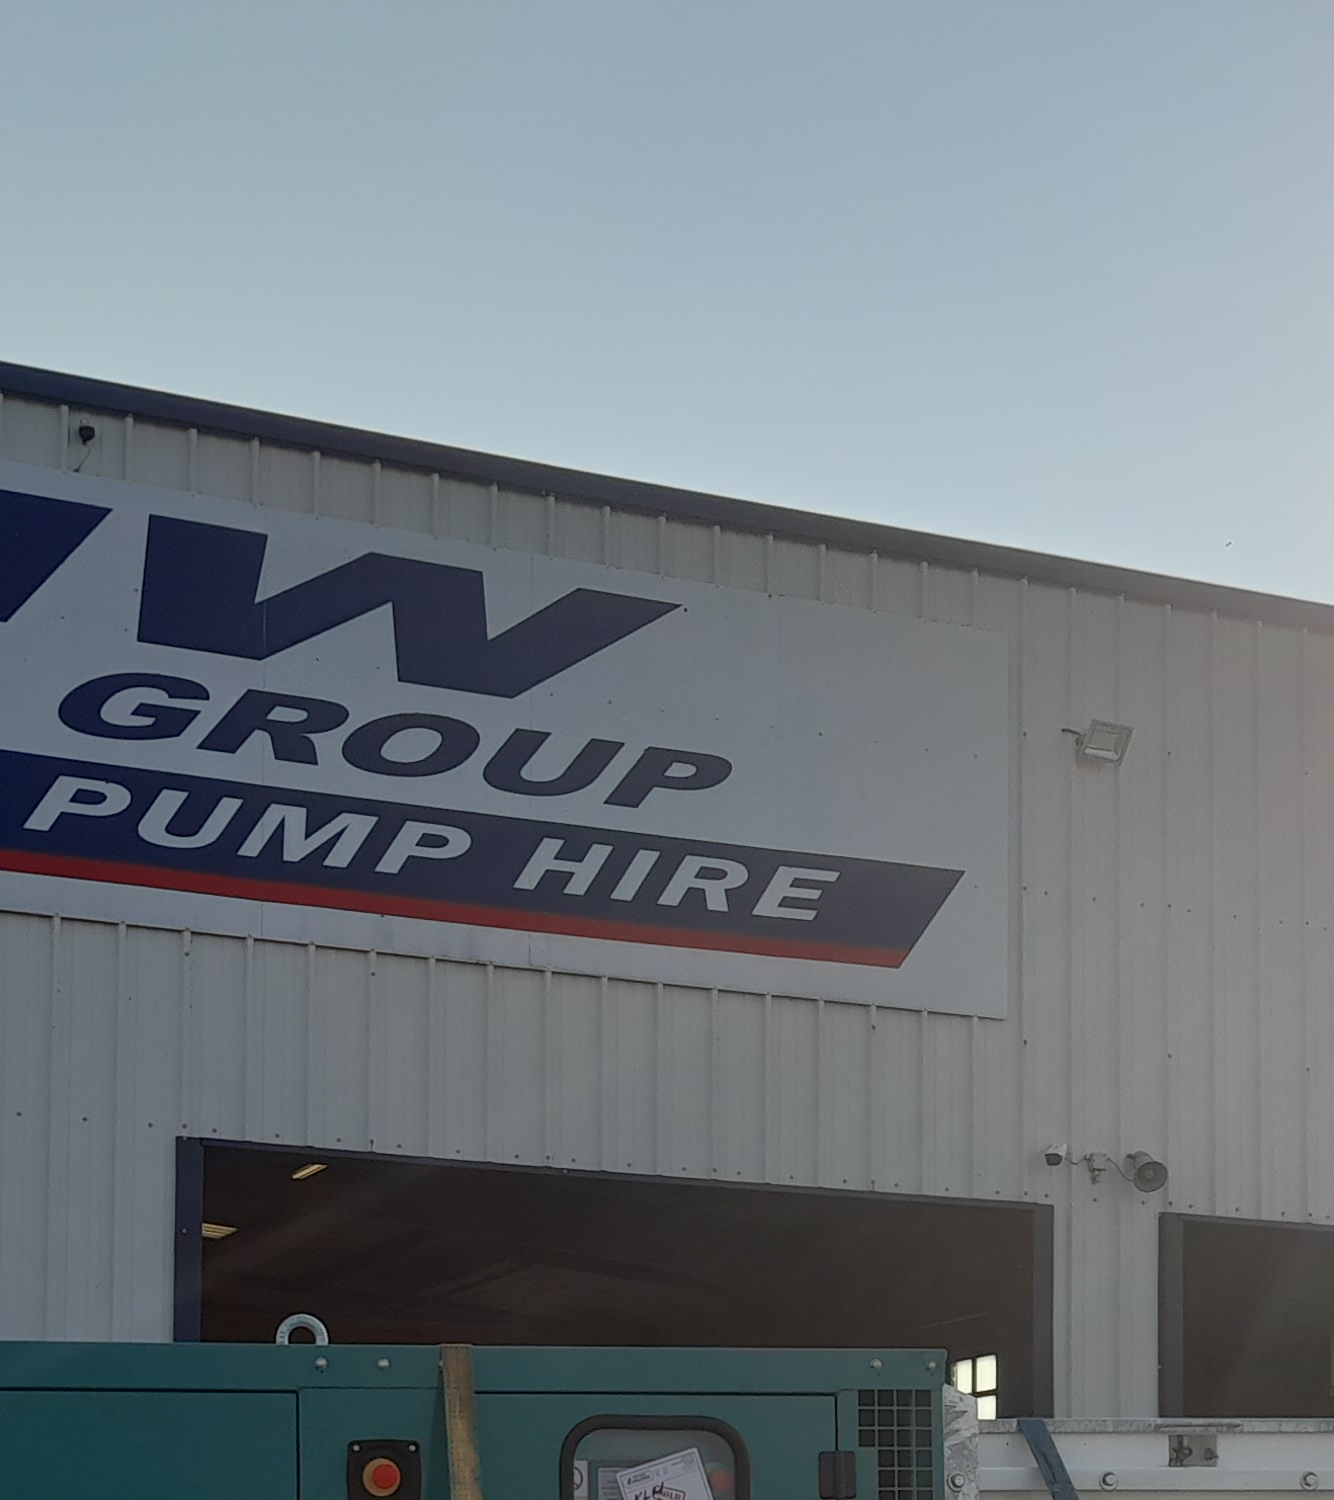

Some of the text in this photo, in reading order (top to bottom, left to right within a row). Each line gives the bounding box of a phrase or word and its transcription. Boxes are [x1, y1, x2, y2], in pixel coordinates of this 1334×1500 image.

[57, 672, 732, 808] GROUP
[23, 776, 472, 873] PUMP
[513, 837, 839, 922] HIRE
